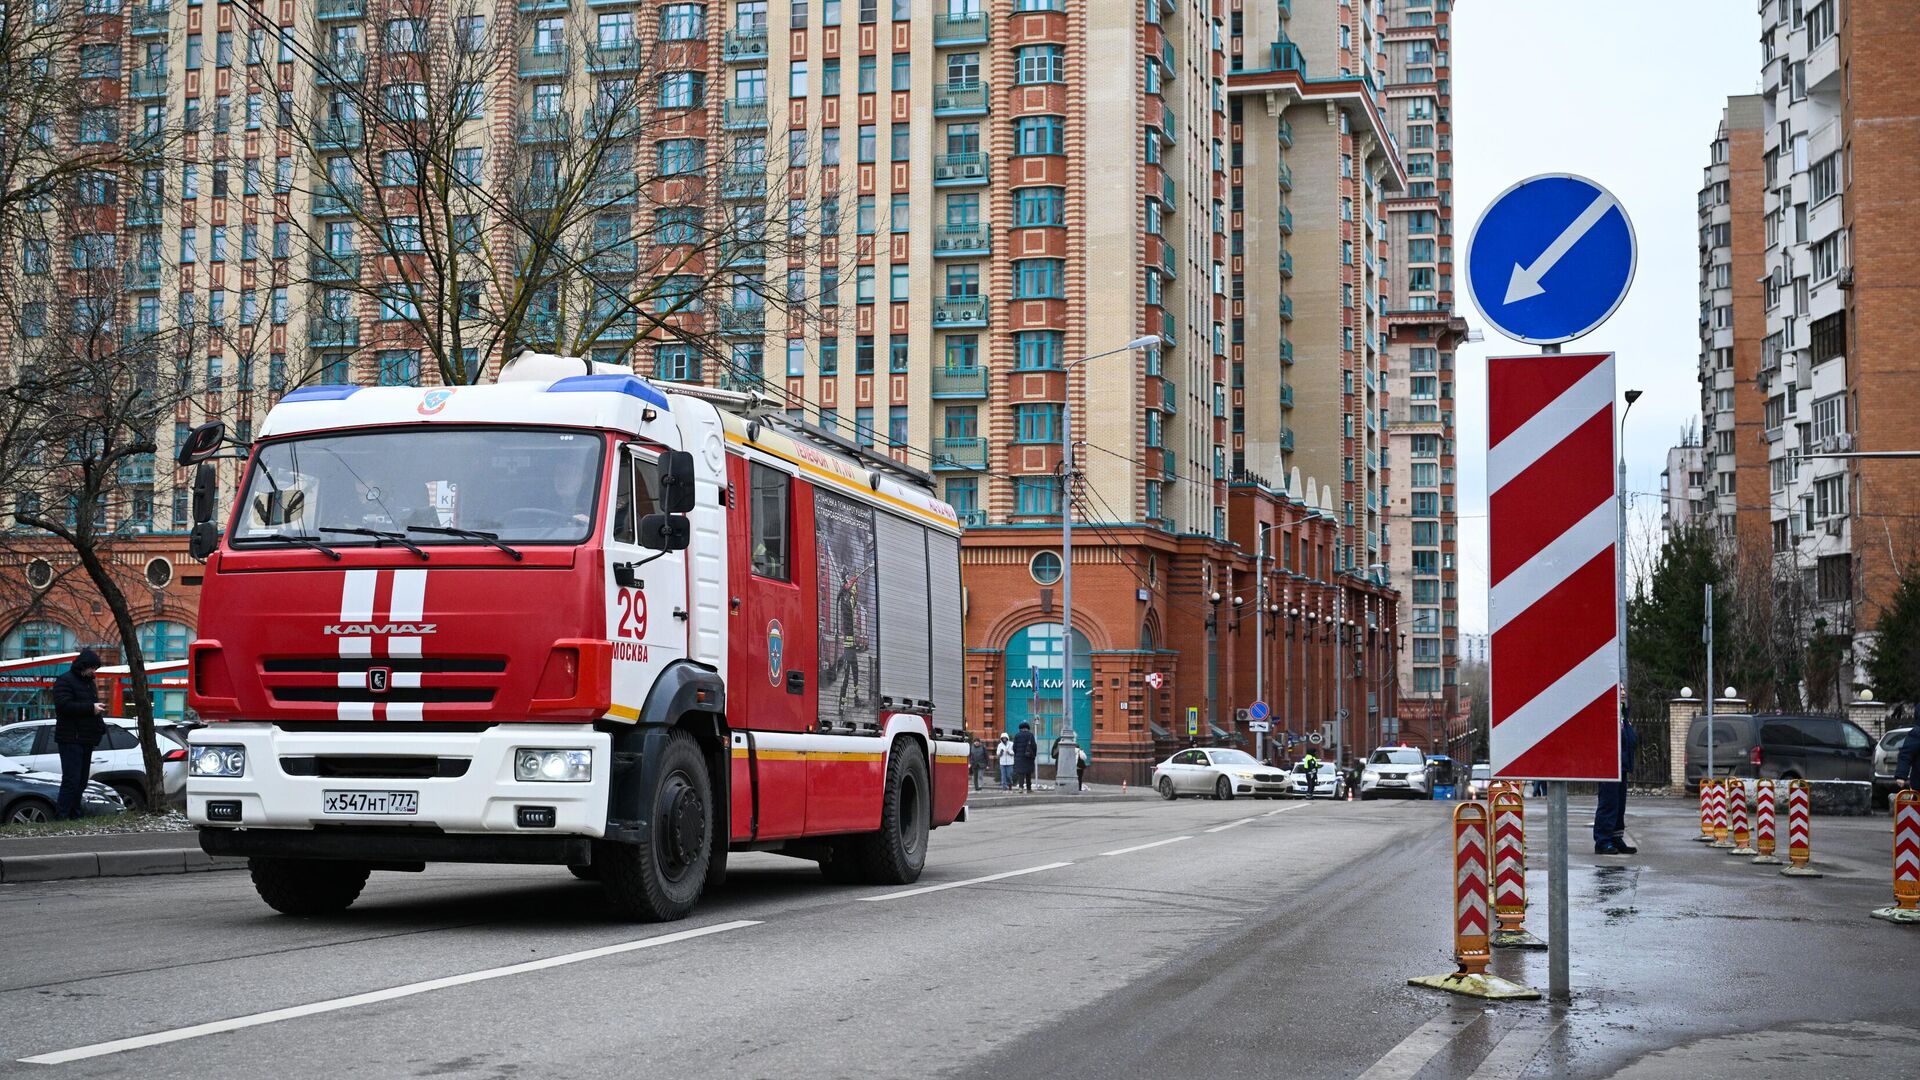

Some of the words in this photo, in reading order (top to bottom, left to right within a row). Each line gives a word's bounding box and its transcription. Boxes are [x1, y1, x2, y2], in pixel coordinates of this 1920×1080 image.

[793, 441, 829, 468] ТЕЛЕФОН
[617, 587, 647, 640] 29
[324, 624, 437, 635] KAMAZ
[612, 641, 648, 663] МОСКВА
[1043, 679, 1086, 689] КЛИИК
[329, 794, 386, 811] Х547НТ
[390, 793, 413, 807] 777
